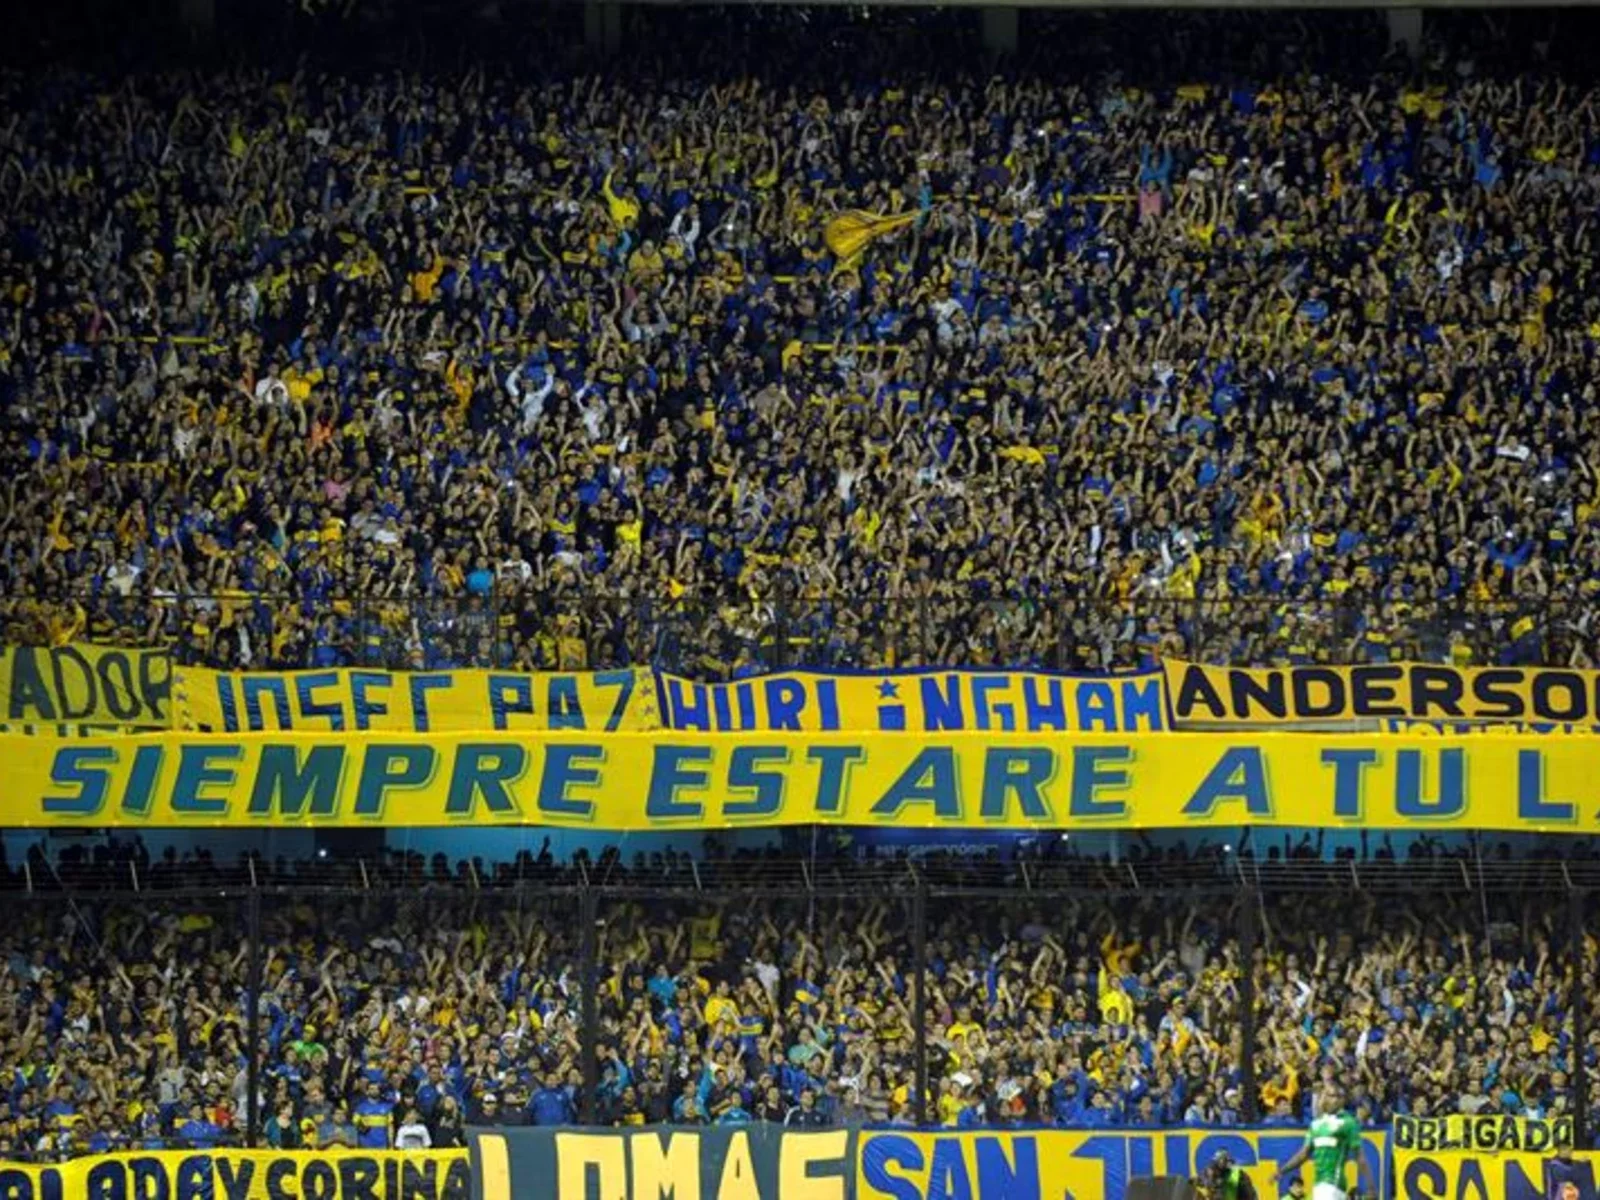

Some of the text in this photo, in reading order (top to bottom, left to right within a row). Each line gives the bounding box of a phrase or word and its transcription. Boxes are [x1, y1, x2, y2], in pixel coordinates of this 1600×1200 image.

[0, 646, 172, 720] ADOR
[1177, 665, 1600, 722] ANDERSO
[42, 743, 1600, 824] SIEMPRE ESTARE A TU L
[1395, 1114, 1572, 1150] OBLIGADO
[862, 1134, 1042, 1200] SAN
